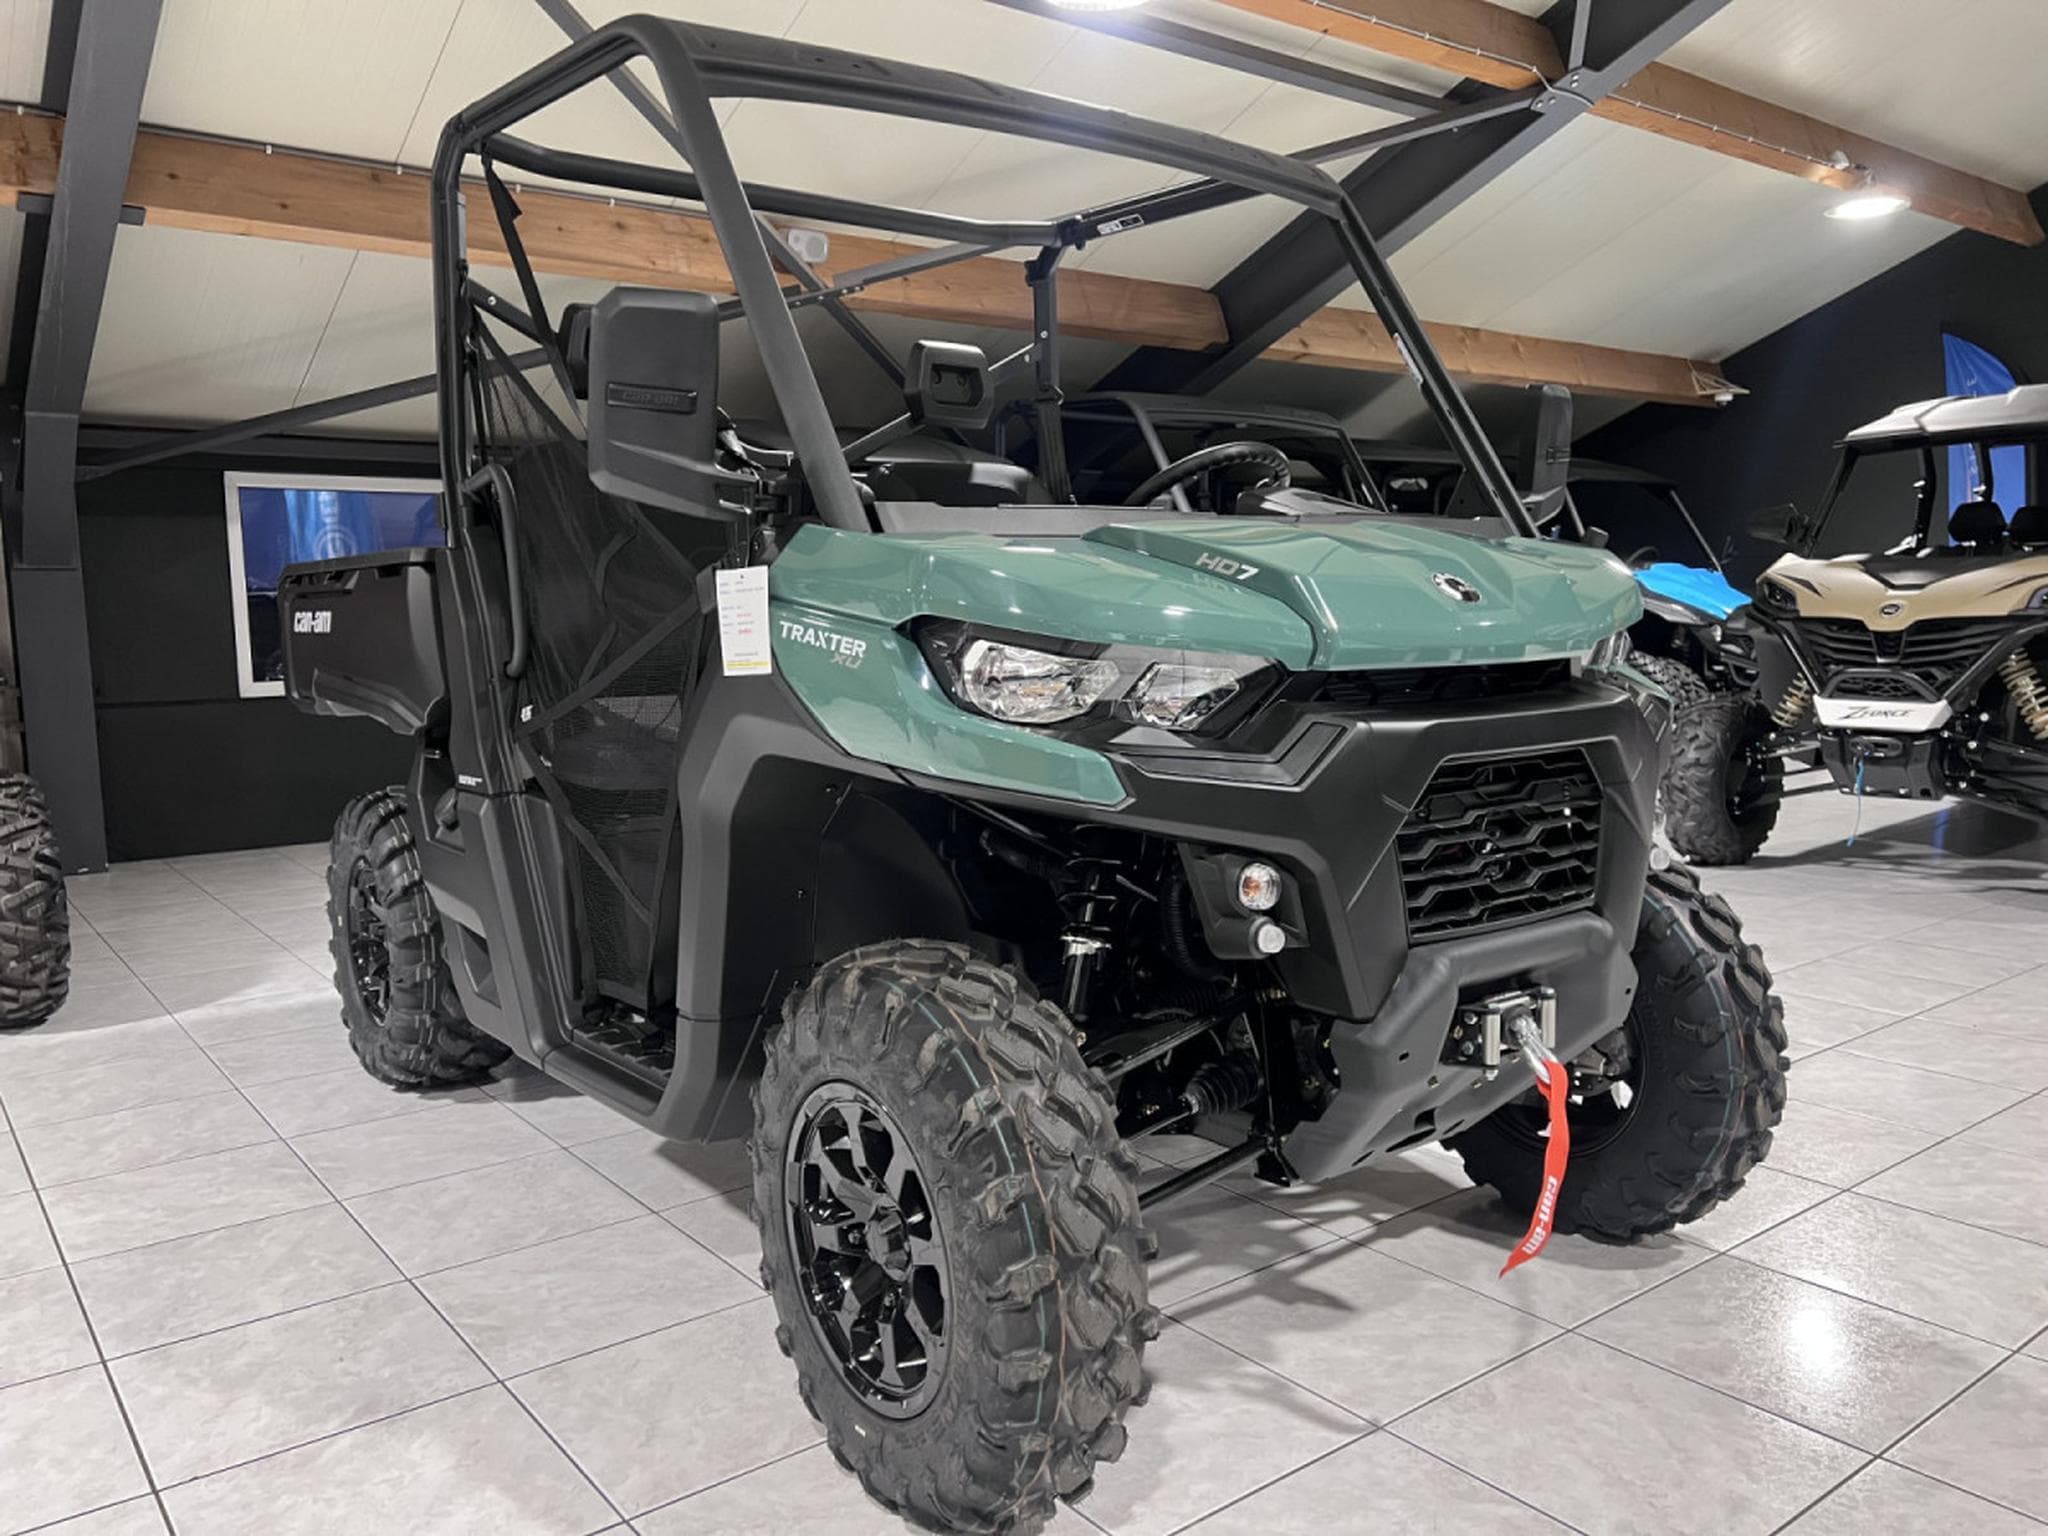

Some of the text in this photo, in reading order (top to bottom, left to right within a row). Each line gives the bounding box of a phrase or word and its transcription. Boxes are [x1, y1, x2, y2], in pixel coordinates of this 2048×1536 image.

[1196, 552, 1259, 580] HD7
[294, 611, 332, 633] can-am
[779, 620, 867, 658] TRAXTER
[1522, 1176, 1558, 1255] can-am
